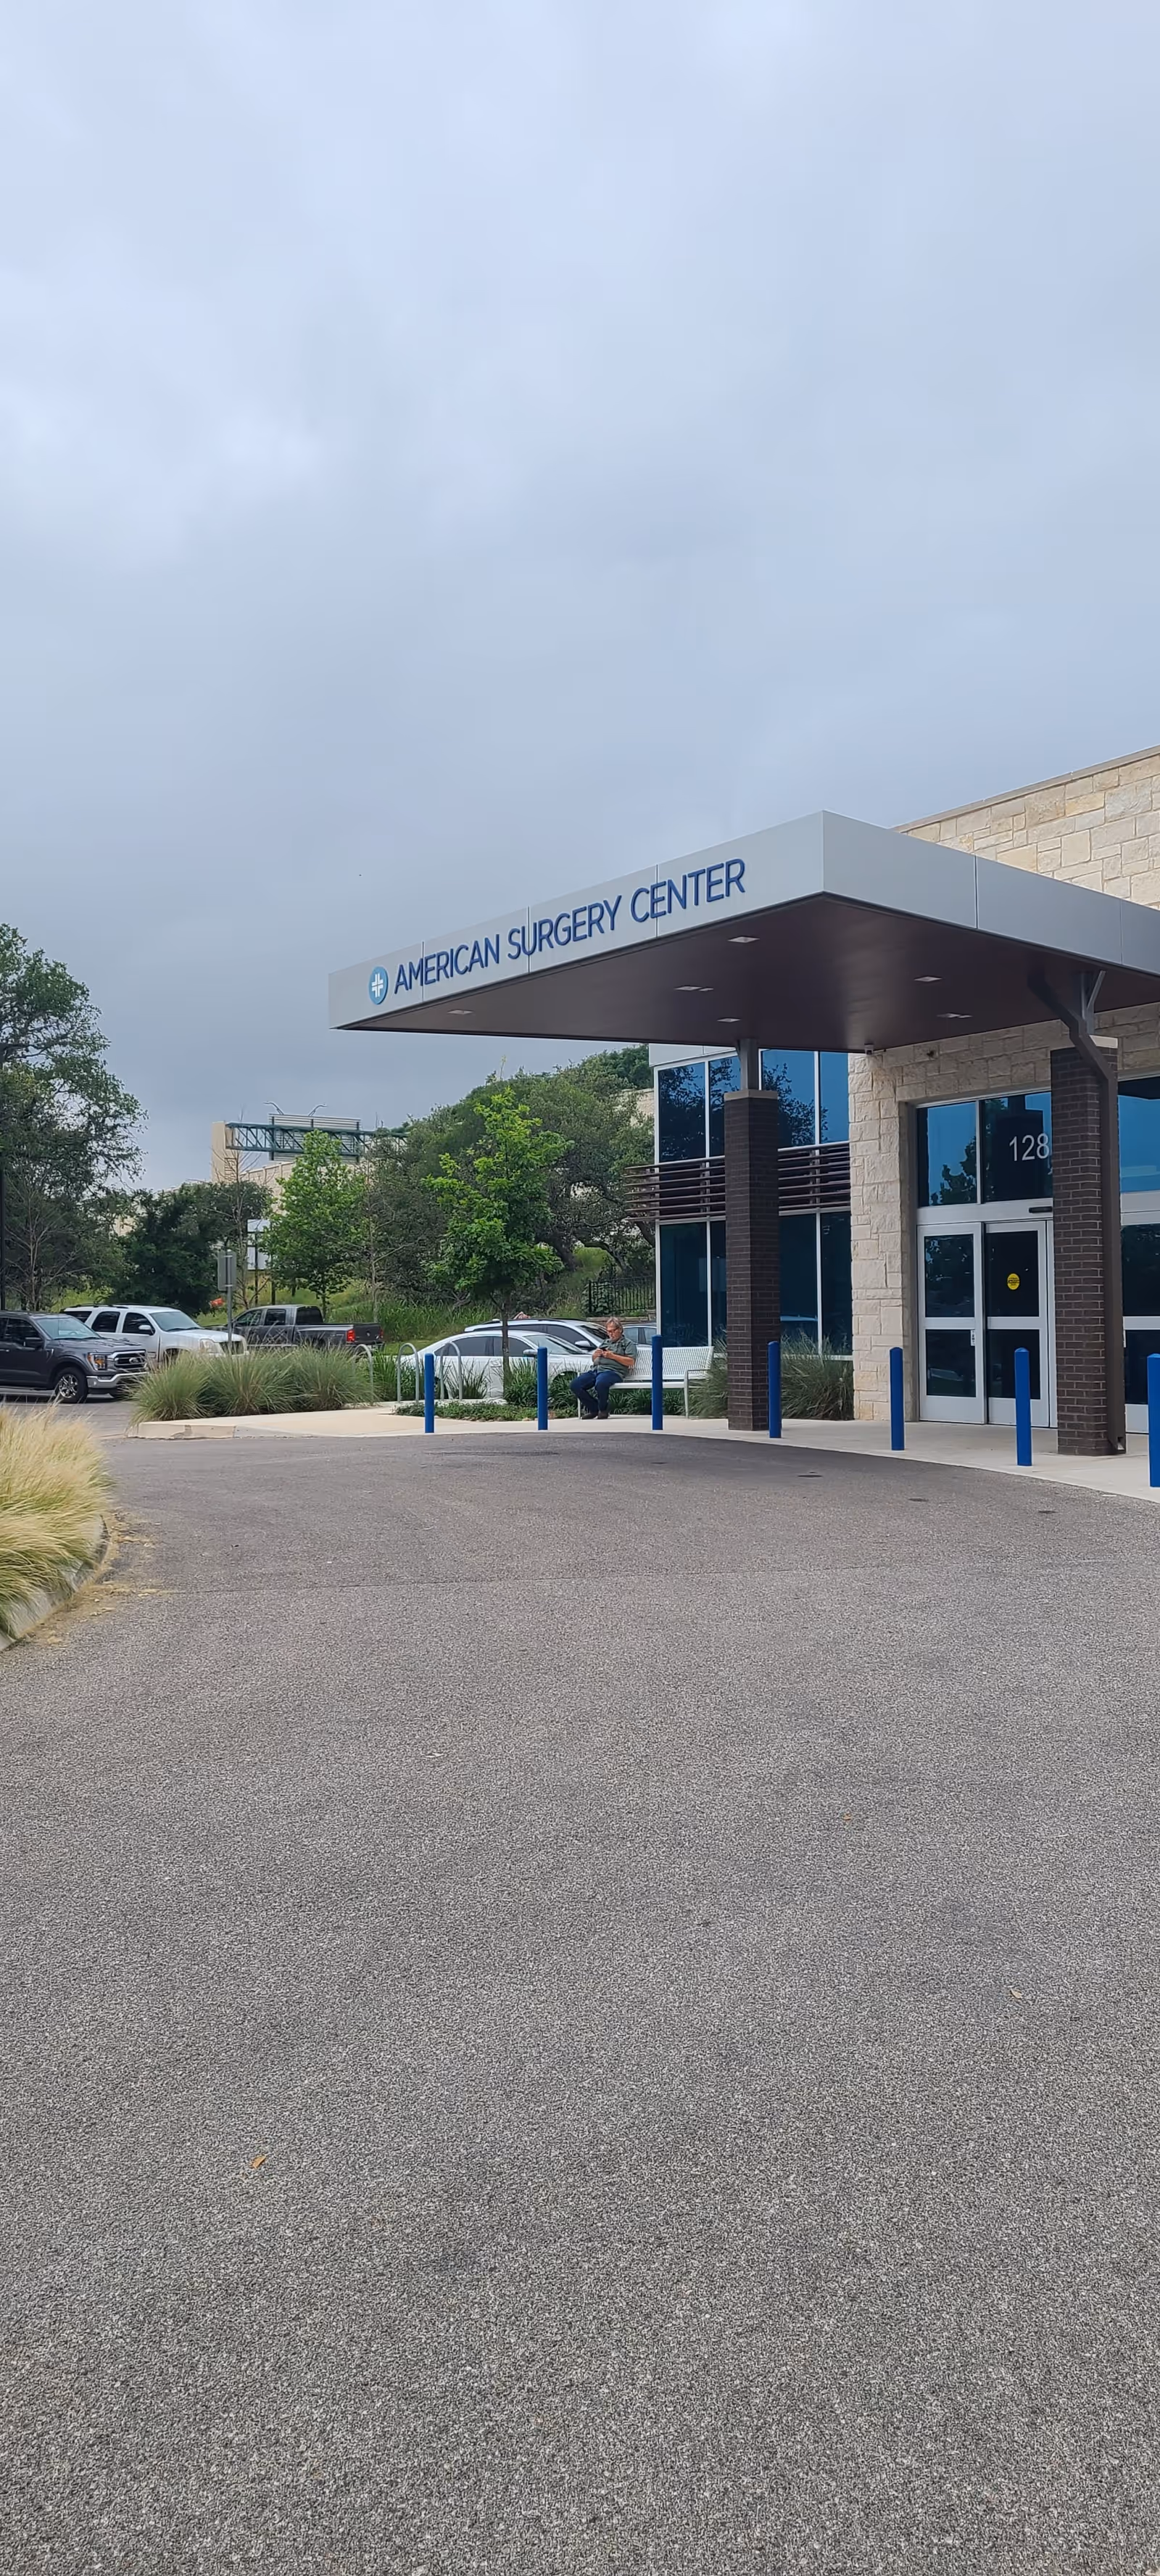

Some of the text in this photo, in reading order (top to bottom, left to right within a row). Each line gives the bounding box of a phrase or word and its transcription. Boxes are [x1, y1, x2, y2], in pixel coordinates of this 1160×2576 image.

[394, 858, 746, 994] AMERICAN SURGERY CENTER
